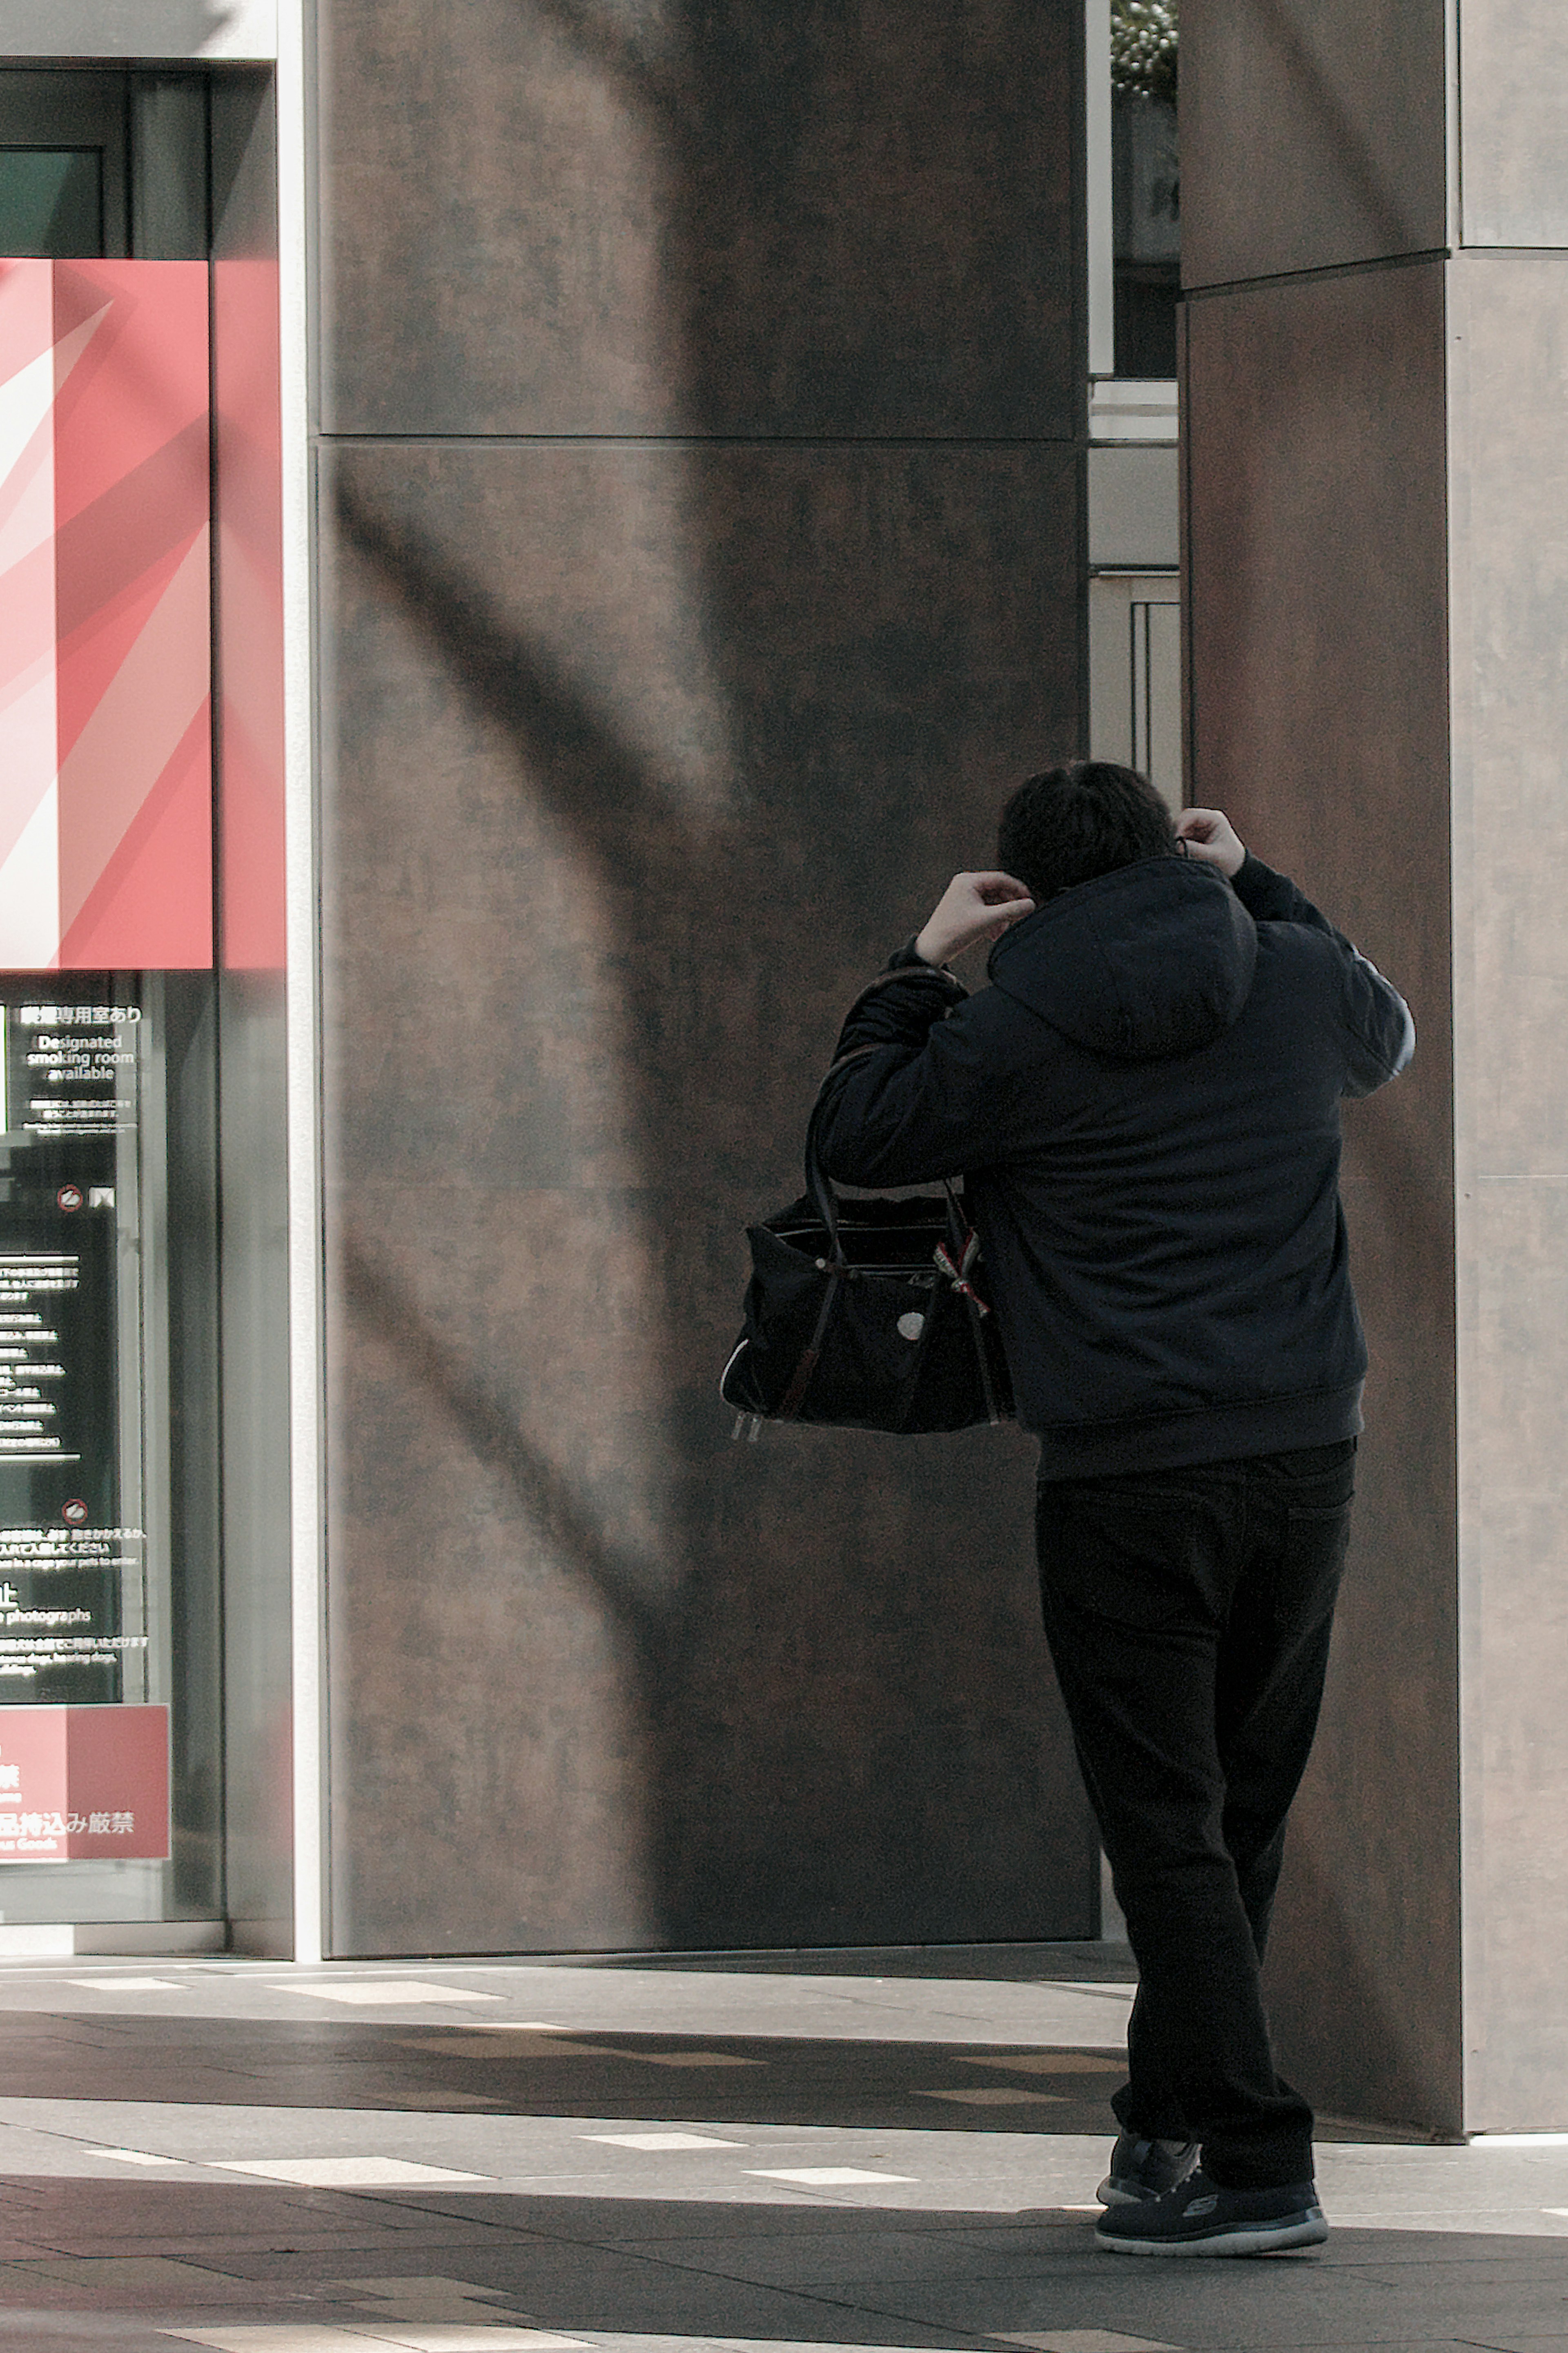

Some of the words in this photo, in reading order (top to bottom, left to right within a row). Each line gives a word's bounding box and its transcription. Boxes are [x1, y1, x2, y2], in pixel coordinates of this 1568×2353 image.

[38, 1035, 122, 1051] Designated
[27, 1051, 91, 1066] smoking
[95, 1053, 134, 1064] room
[47, 1066, 114, 1080] available
[6, 1608, 91, 1625] photographs
